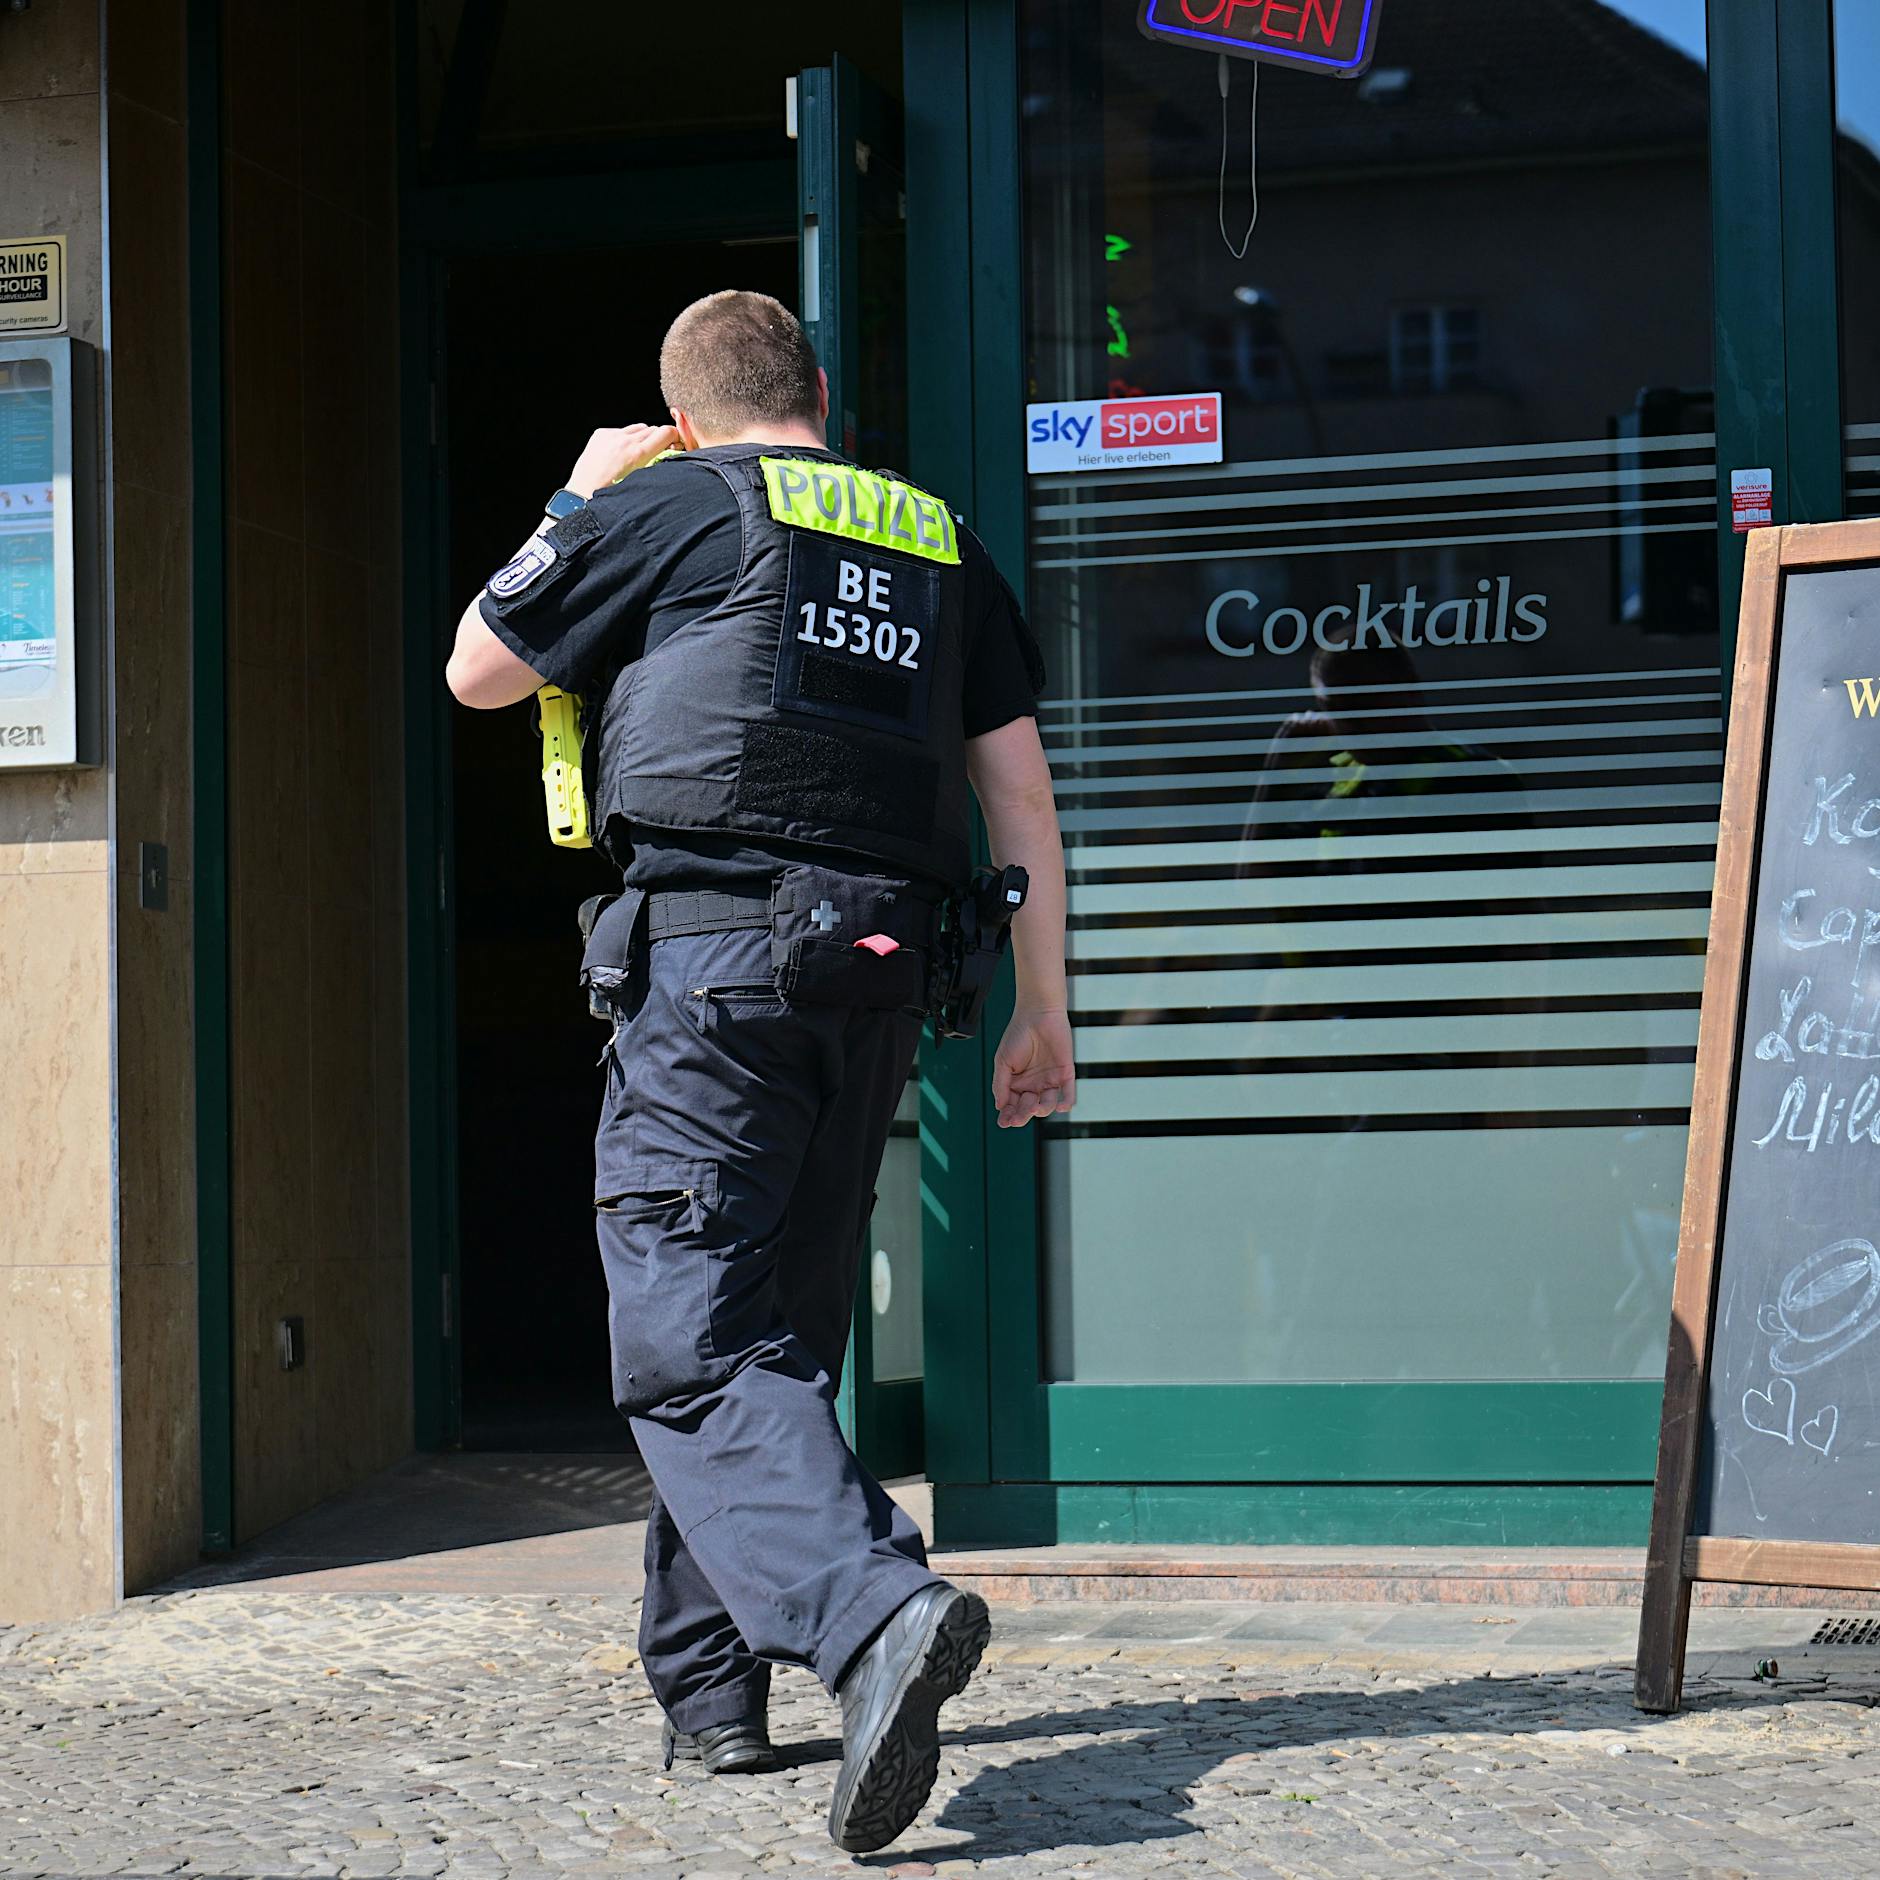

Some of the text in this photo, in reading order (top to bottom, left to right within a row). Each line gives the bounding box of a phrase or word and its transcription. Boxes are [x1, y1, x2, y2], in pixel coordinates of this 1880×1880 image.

[0, 278, 42, 293] HOUR
[20, 316, 48, 324] cameras
[1031, 405, 1210, 448] sky sport
[1078, 451, 1171, 465] Hier live erleben
[776, 465, 951, 552] POLIZEI
[837, 559, 892, 612] BE
[797, 601, 921, 670] 15302
[1205, 575, 1547, 657] Cocktails
